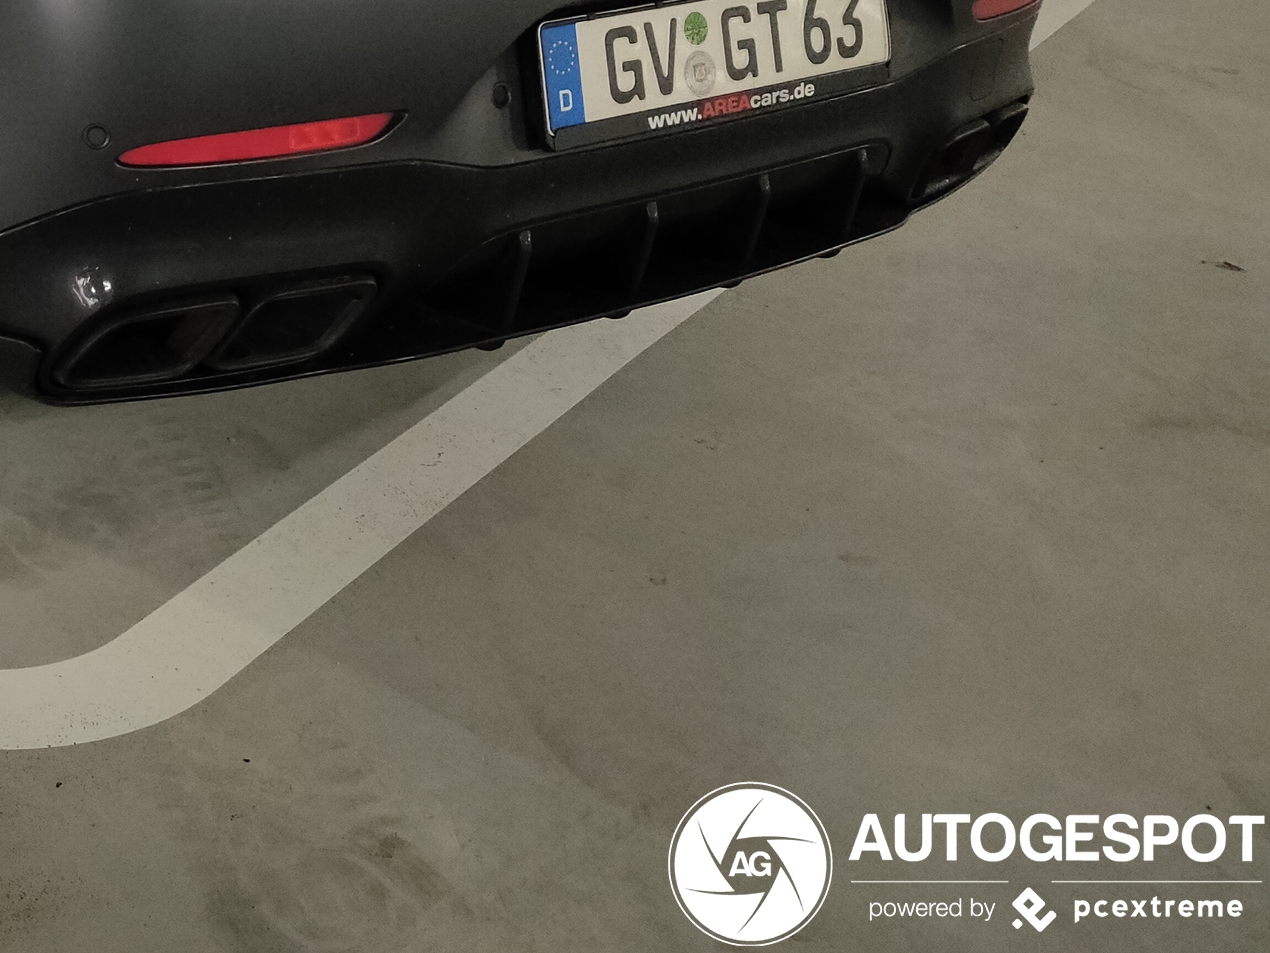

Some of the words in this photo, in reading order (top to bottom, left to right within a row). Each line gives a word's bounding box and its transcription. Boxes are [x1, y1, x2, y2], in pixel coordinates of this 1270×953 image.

[604, 17, 678, 105] GV
[558, 88, 574, 113] D
[647, 82, 817, 131] www.AREAcars.de
